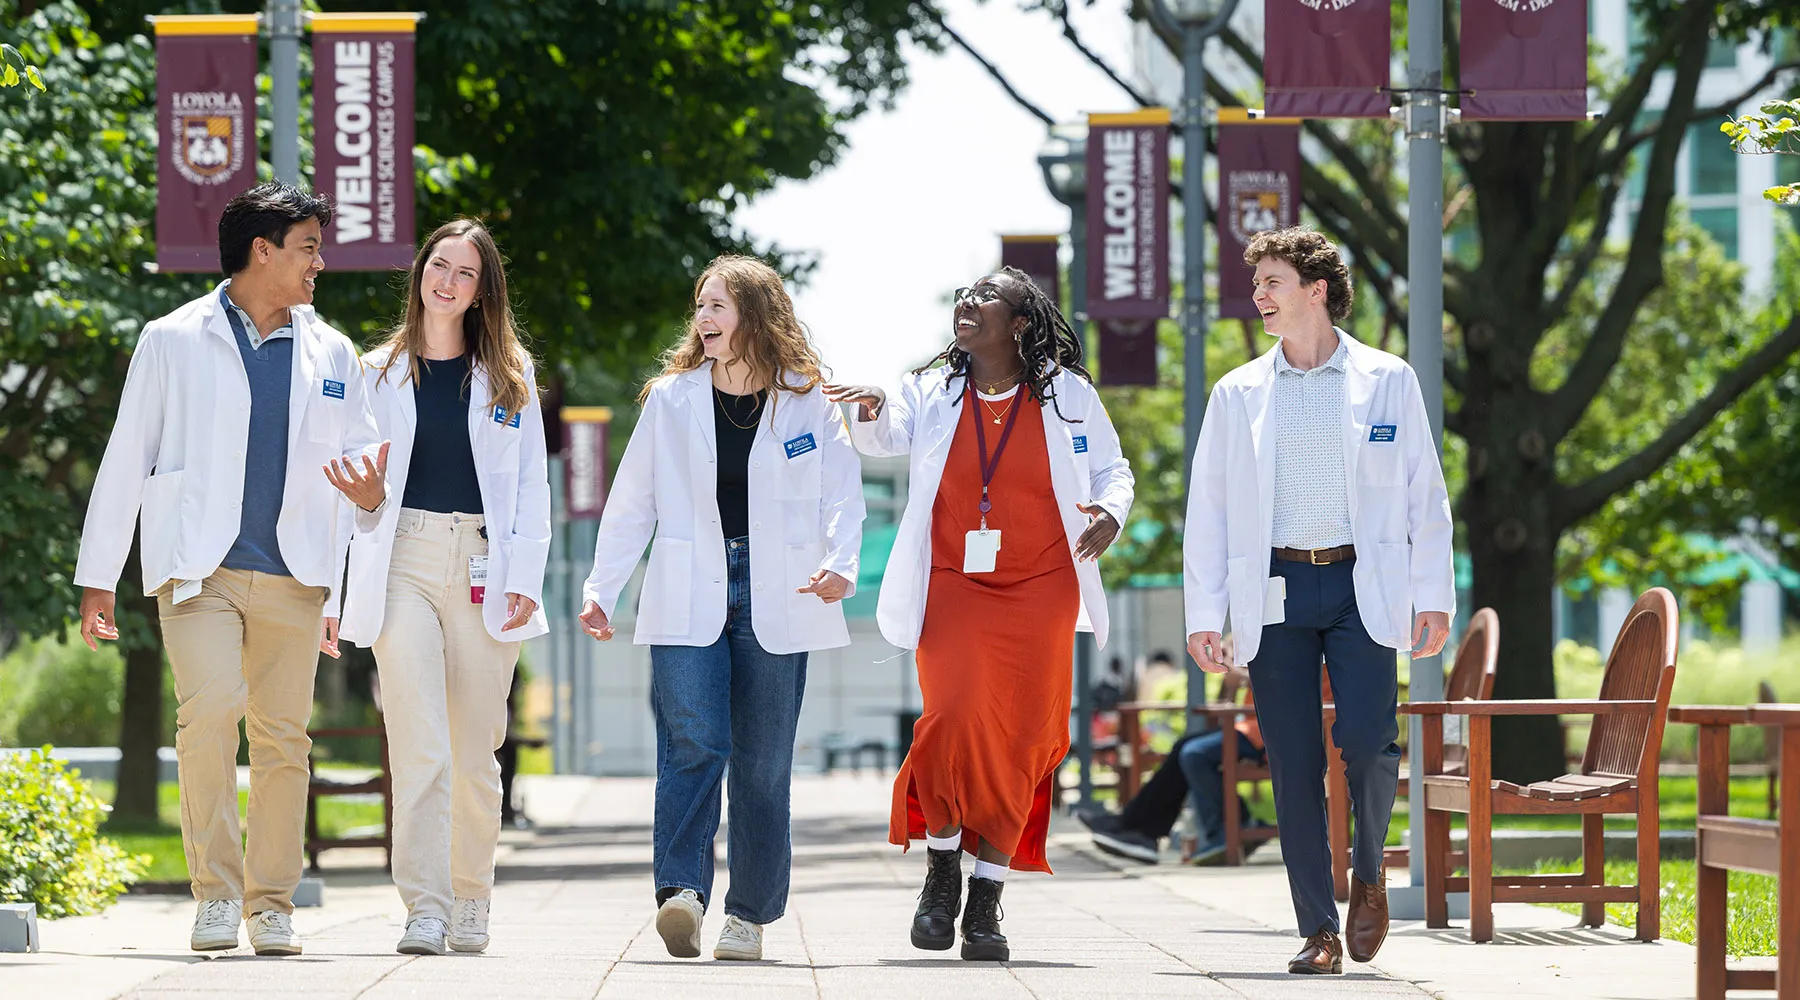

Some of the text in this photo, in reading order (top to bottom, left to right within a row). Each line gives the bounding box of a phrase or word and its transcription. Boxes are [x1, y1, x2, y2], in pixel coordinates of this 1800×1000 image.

[172, 92, 243, 109] LOYOLA
[335, 41, 372, 244] WELCOME
[377, 41, 395, 243] HEALTH SCIENCES CAMPUS
[1103, 129, 1137, 300] WELCOME
